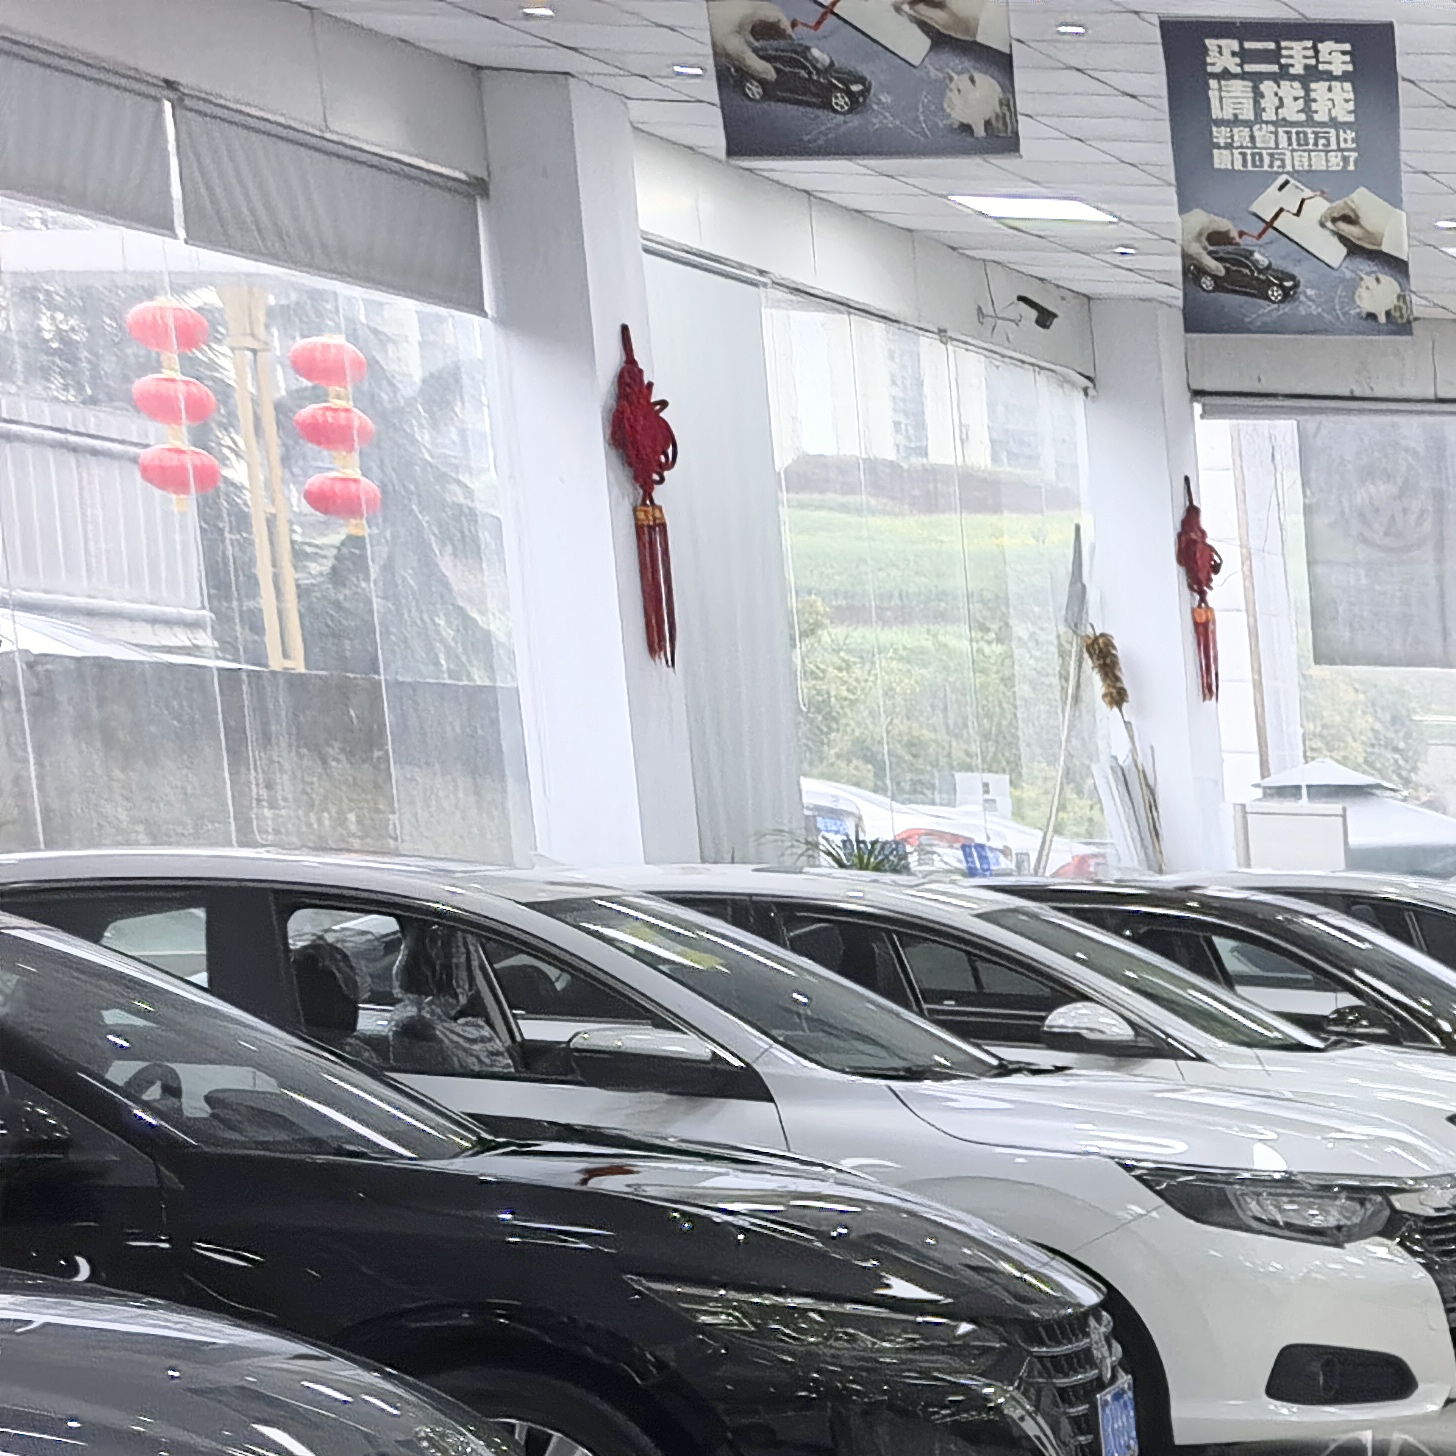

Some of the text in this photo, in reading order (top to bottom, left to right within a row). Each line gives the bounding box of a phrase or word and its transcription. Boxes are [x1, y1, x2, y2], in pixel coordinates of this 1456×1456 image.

[1204, 38, 1353, 75] 买二手车
[1208, 79, 1355, 122] 请找我
